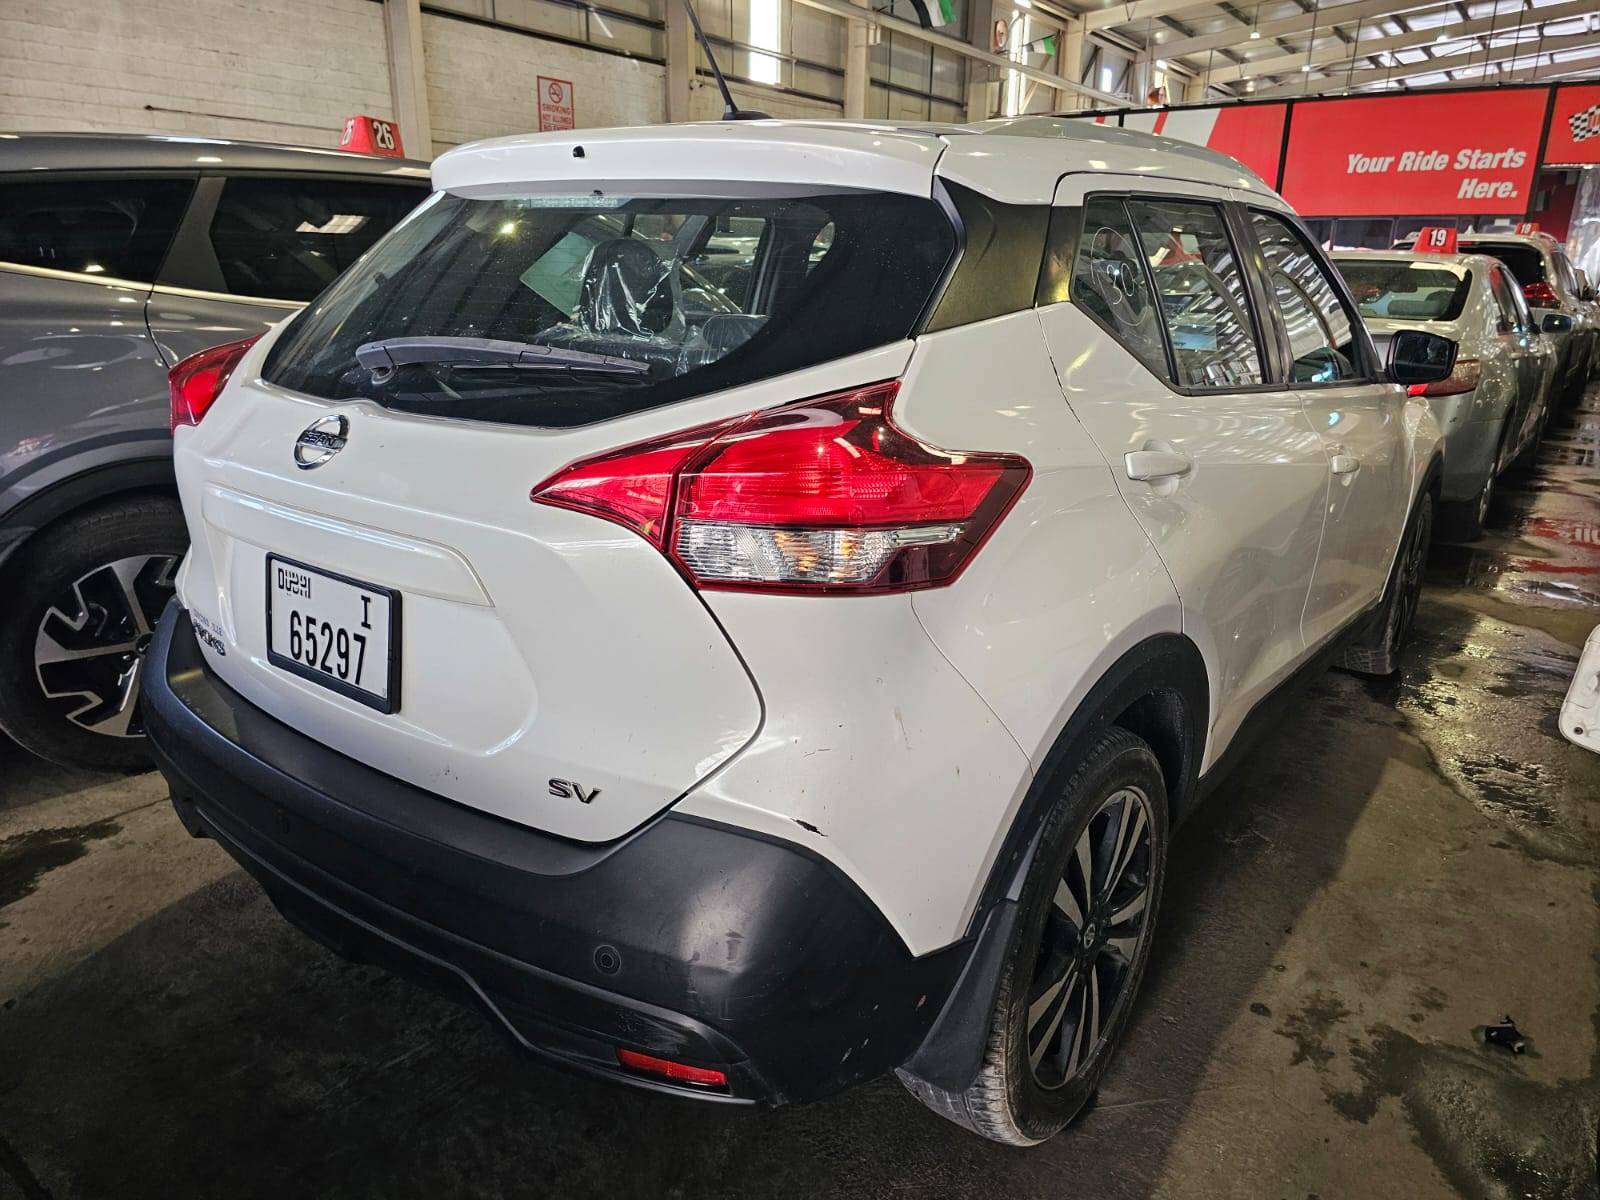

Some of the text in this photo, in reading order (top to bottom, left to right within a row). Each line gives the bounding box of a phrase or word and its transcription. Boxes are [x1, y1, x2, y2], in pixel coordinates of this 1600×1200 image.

[373, 121, 395, 150] 26
[1347, 148, 1527, 174] Your Ride Starts
[1457, 178, 1519, 199] Here.
[1430, 229, 1447, 247] 19
[290, 609, 367, 686] 65297
[548, 777, 602, 804] SV
